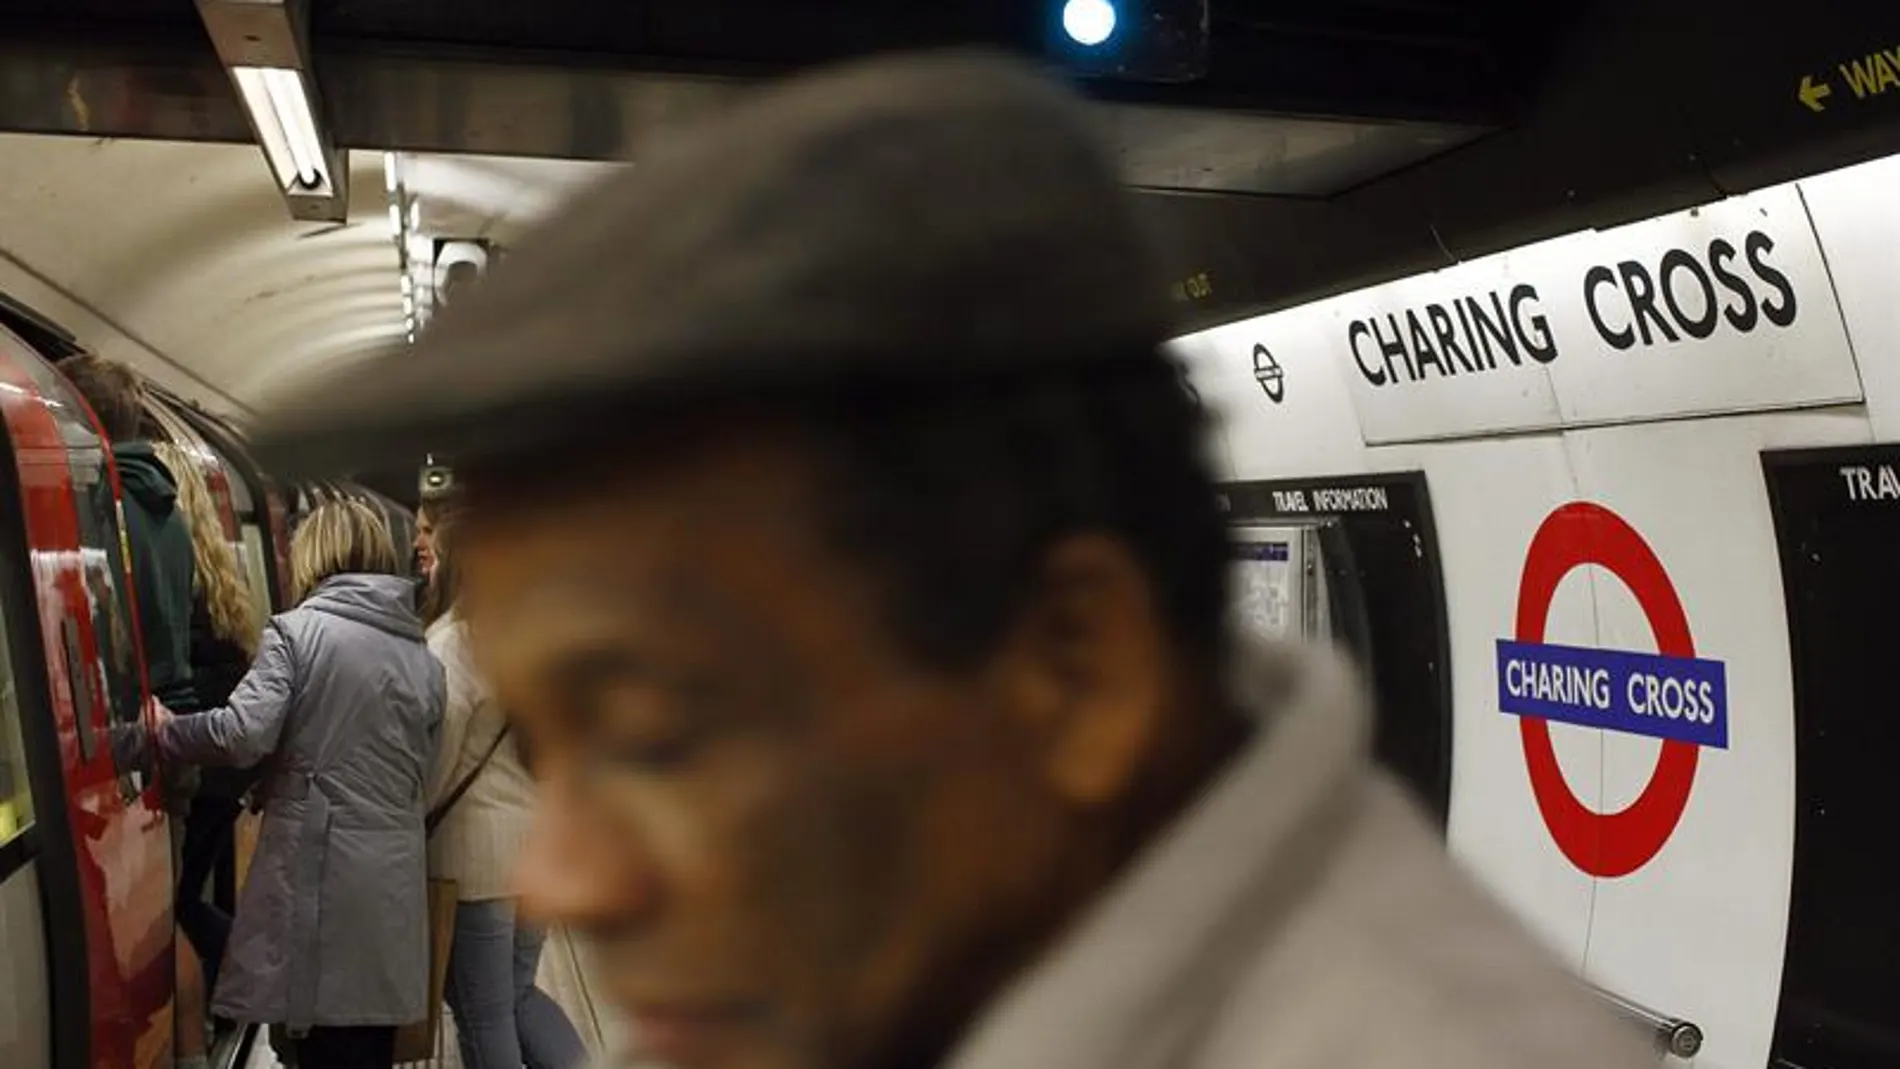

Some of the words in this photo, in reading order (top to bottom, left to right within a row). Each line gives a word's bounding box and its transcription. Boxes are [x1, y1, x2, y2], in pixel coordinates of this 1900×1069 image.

[1348, 283, 1558, 387] CHARING
[1583, 229, 1798, 351] CROSS
[1272, 490, 1309, 512] TRAVEL
[1312, 487, 1388, 512] INFORMATION
[1506, 659, 1610, 710] CHARING
[1627, 671, 1715, 725] CROSS
